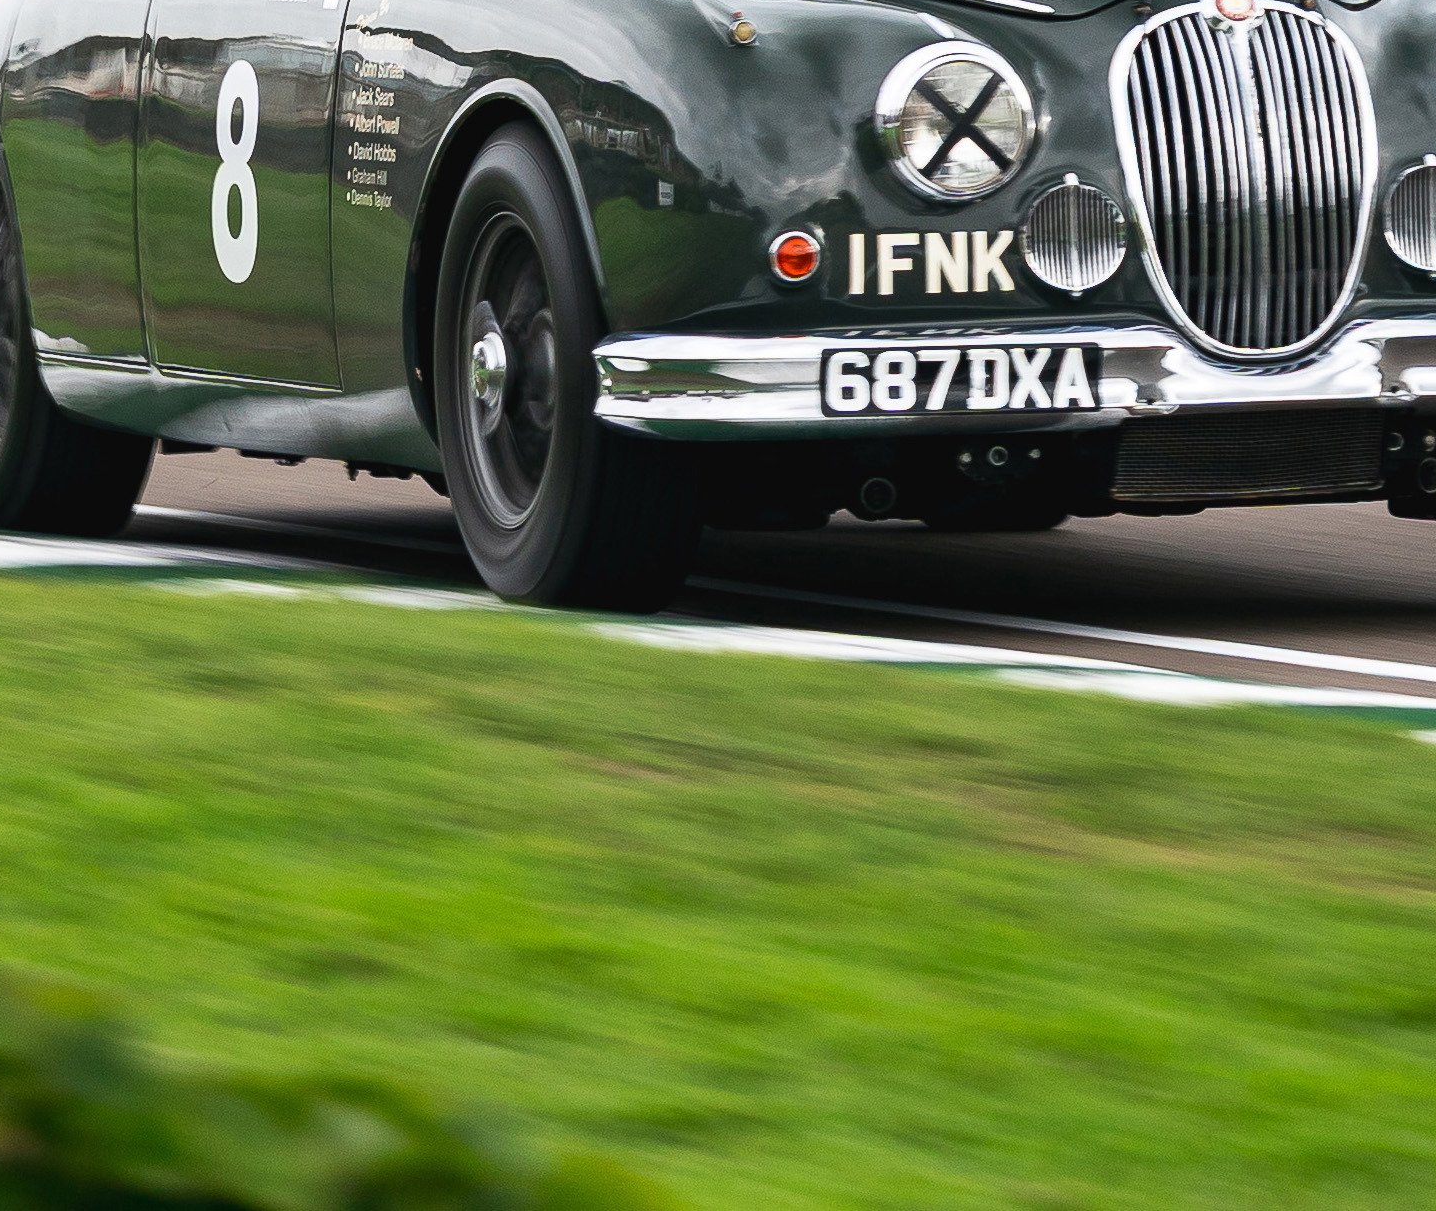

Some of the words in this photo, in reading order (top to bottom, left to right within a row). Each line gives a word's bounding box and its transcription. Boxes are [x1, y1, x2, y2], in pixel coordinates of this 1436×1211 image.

[357, 85, 374, 106] Jack
[375, 87, 395, 107] Sears
[354, 114, 375, 133] Albert
[376, 115, 400, 135] Powell
[353, 142, 373, 161] David
[374, 143, 397, 162] Hobbs
[211, 59, 260, 284] 8
[353, 168, 376, 184] Graham
[352, 189, 373, 206] Dennis
[374, 191, 393, 211] Taylor
